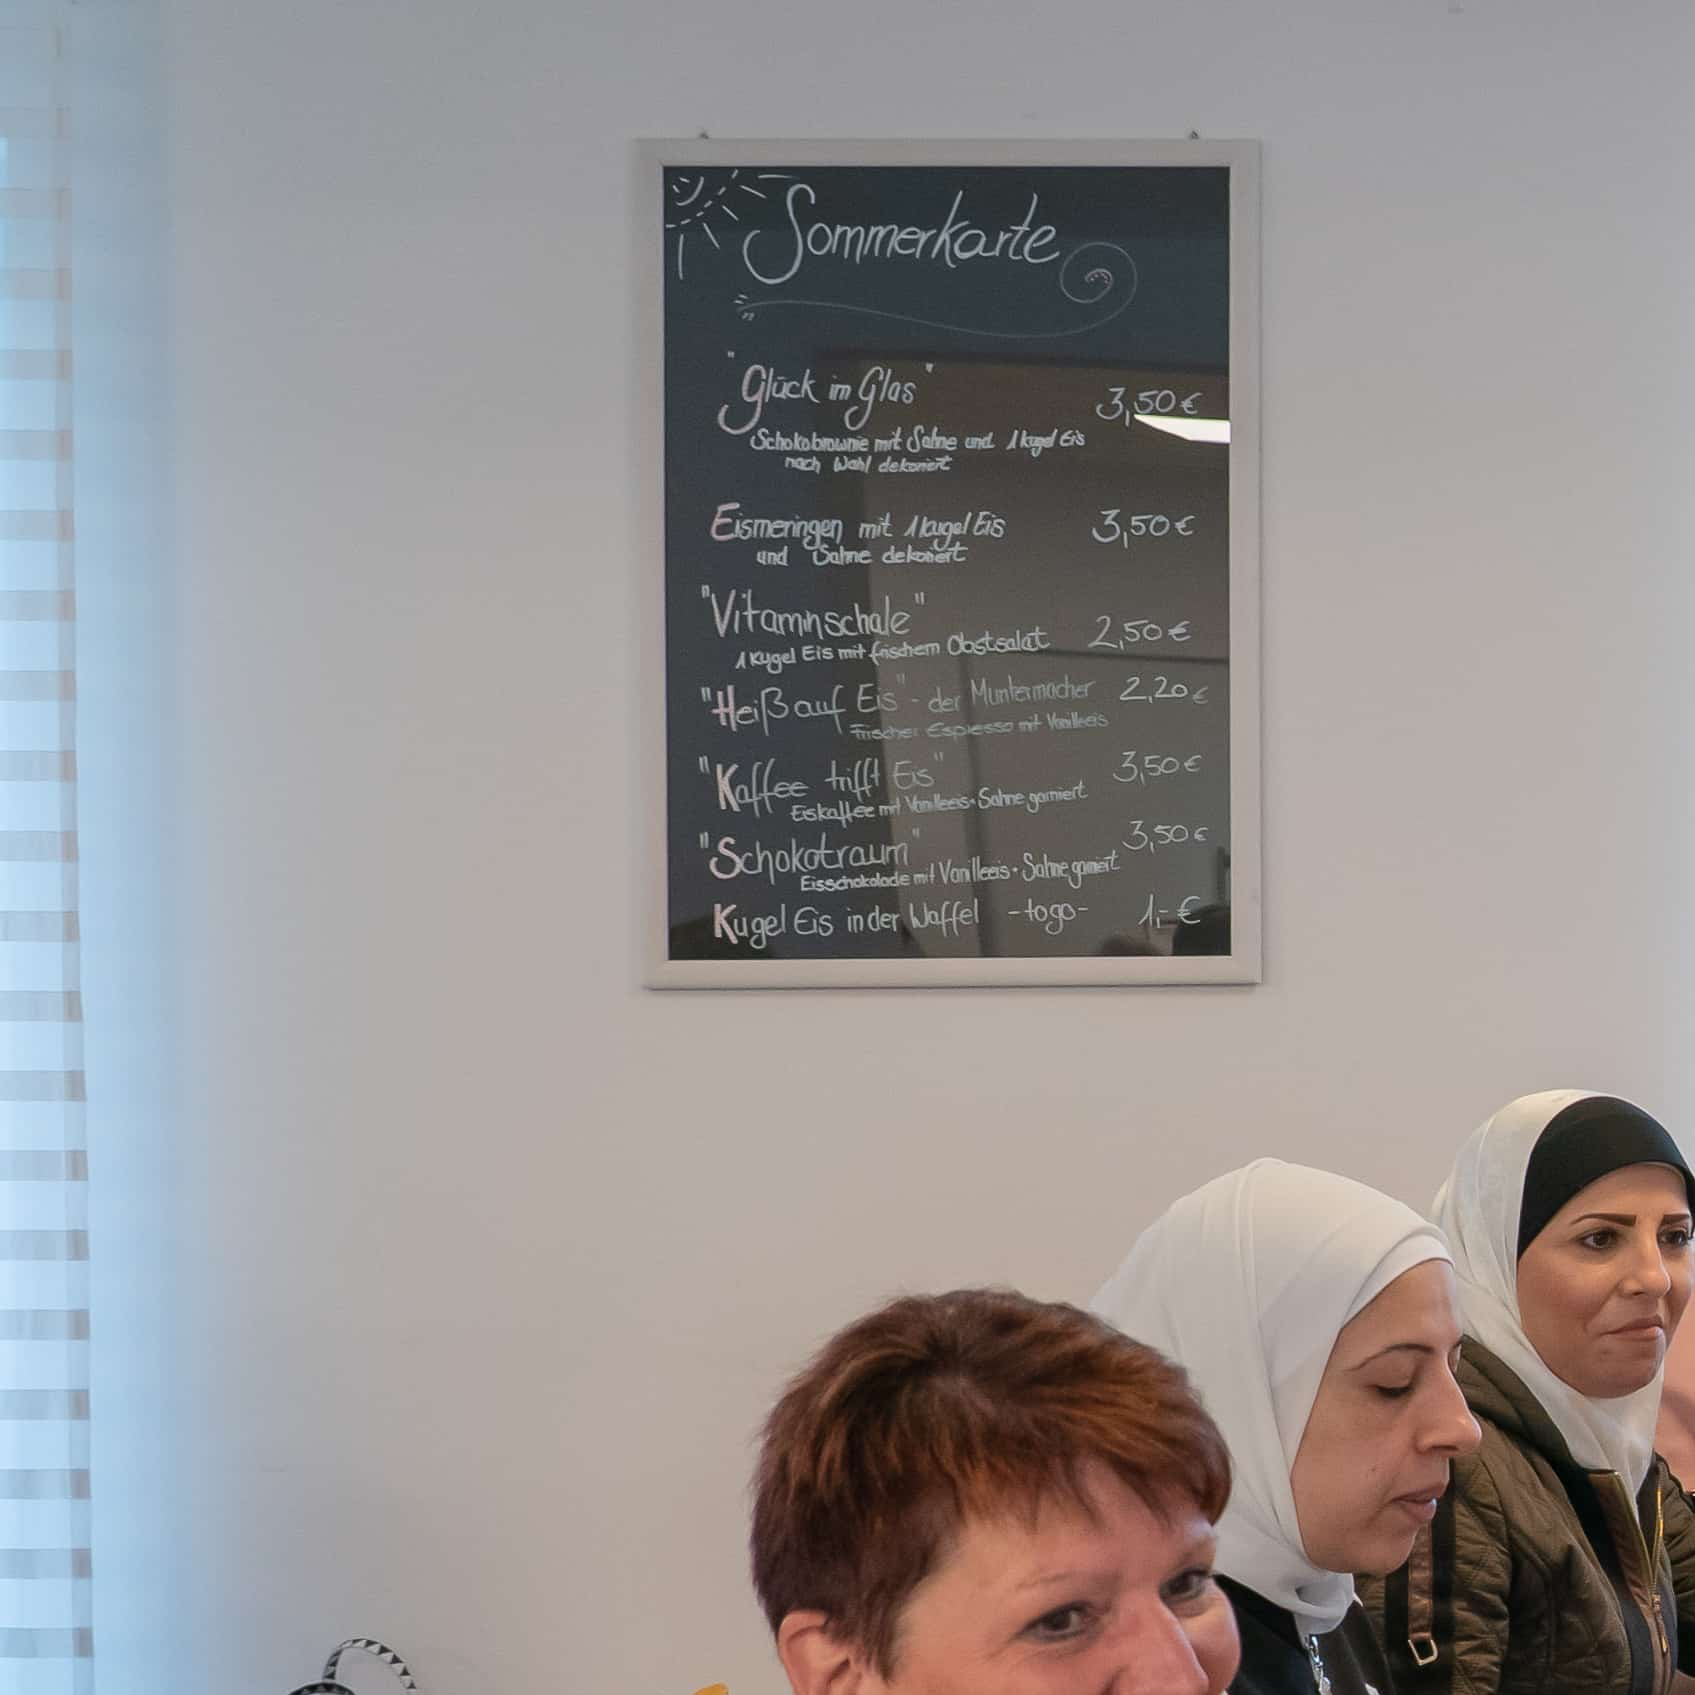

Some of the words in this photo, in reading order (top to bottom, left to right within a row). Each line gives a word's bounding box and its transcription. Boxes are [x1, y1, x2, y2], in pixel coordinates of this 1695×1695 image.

[743, 184, 1061, 285] Sommerkarte
[829, 374, 851, 401] im
[874, 426, 902, 453] mit
[906, 425, 959, 454] Sahne
[965, 431, 996, 450] und
[784, 456, 821, 473] nach
[833, 456, 872, 474] Wahl
[878, 455, 953, 474] dekoriert
[858, 511, 894, 540] mit
[972, 511, 1007, 538] Eis
[756, 545, 789, 566] und
[812, 546, 872, 567] Sahne
[881, 541, 969, 565] dekoriert
[802, 645, 834, 662] Eis
[837, 644, 866, 661] mit
[866, 640, 940, 666] frischem
[946, 625, 1051, 656] Obstsalat
[793, 684, 847, 734] auf
[927, 687, 961, 713] der
[1018, 714, 1042, 733] mit
[824, 757, 881, 802] trifft
[977, 786, 1026, 810] Sahne
[914, 864, 936, 883] mit
[1022, 852, 1070, 882] Sahne
[713, 903, 786, 950] Kugel
[793, 905, 834, 937] Eis
[909, 898, 979, 937] Waffel
